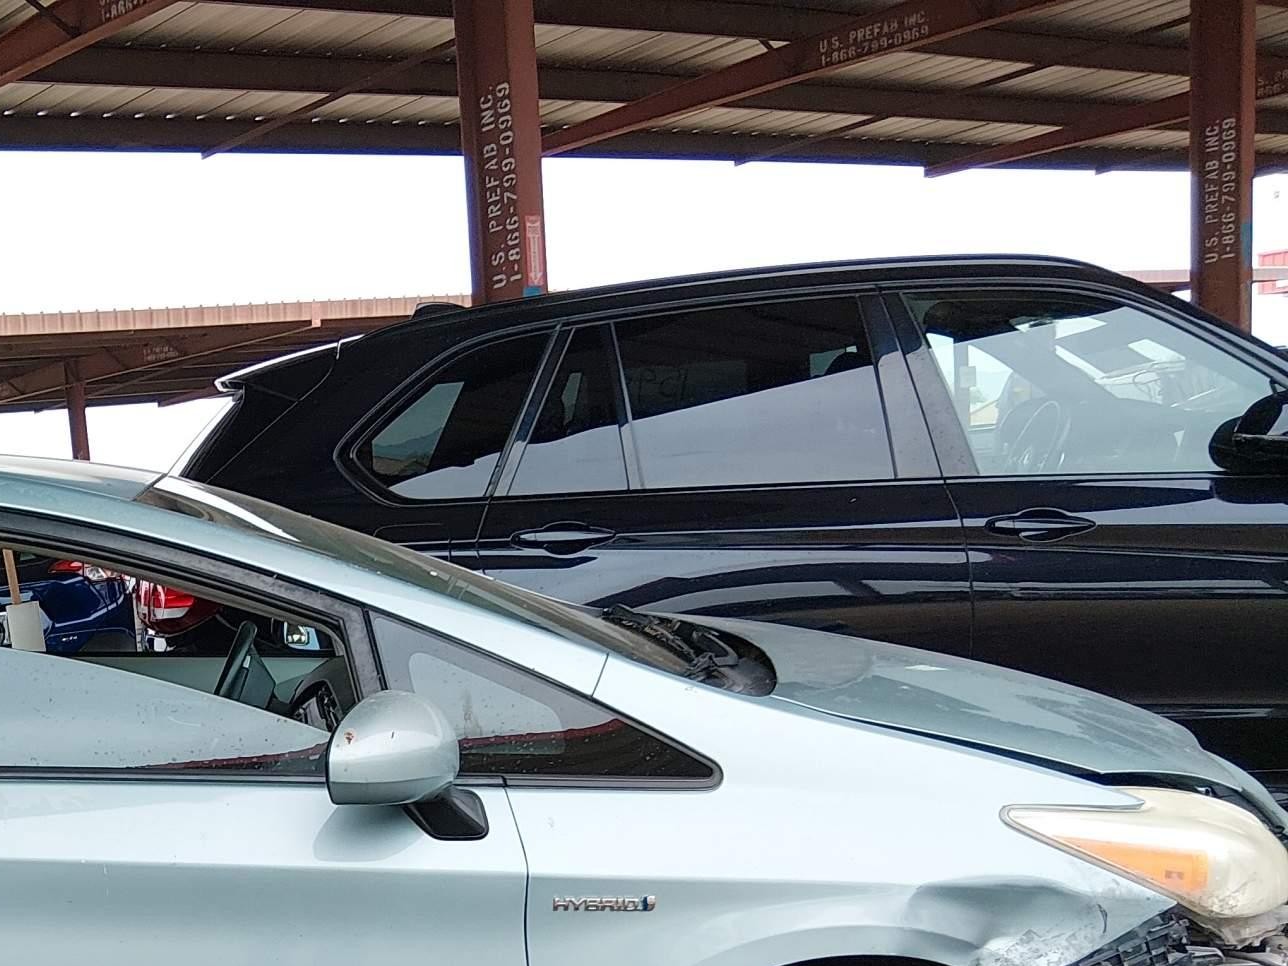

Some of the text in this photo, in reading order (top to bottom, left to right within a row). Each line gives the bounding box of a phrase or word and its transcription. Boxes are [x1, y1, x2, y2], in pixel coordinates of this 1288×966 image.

[483, 143, 504, 234] PREFAB
[495, 82, 522, 283] 1-866-799-0969
[1205, 160, 1220, 224] PREFAB
[1221, 117, 1237, 259] 1-866-799-0969
[553, 896, 639, 912] HYBRID
